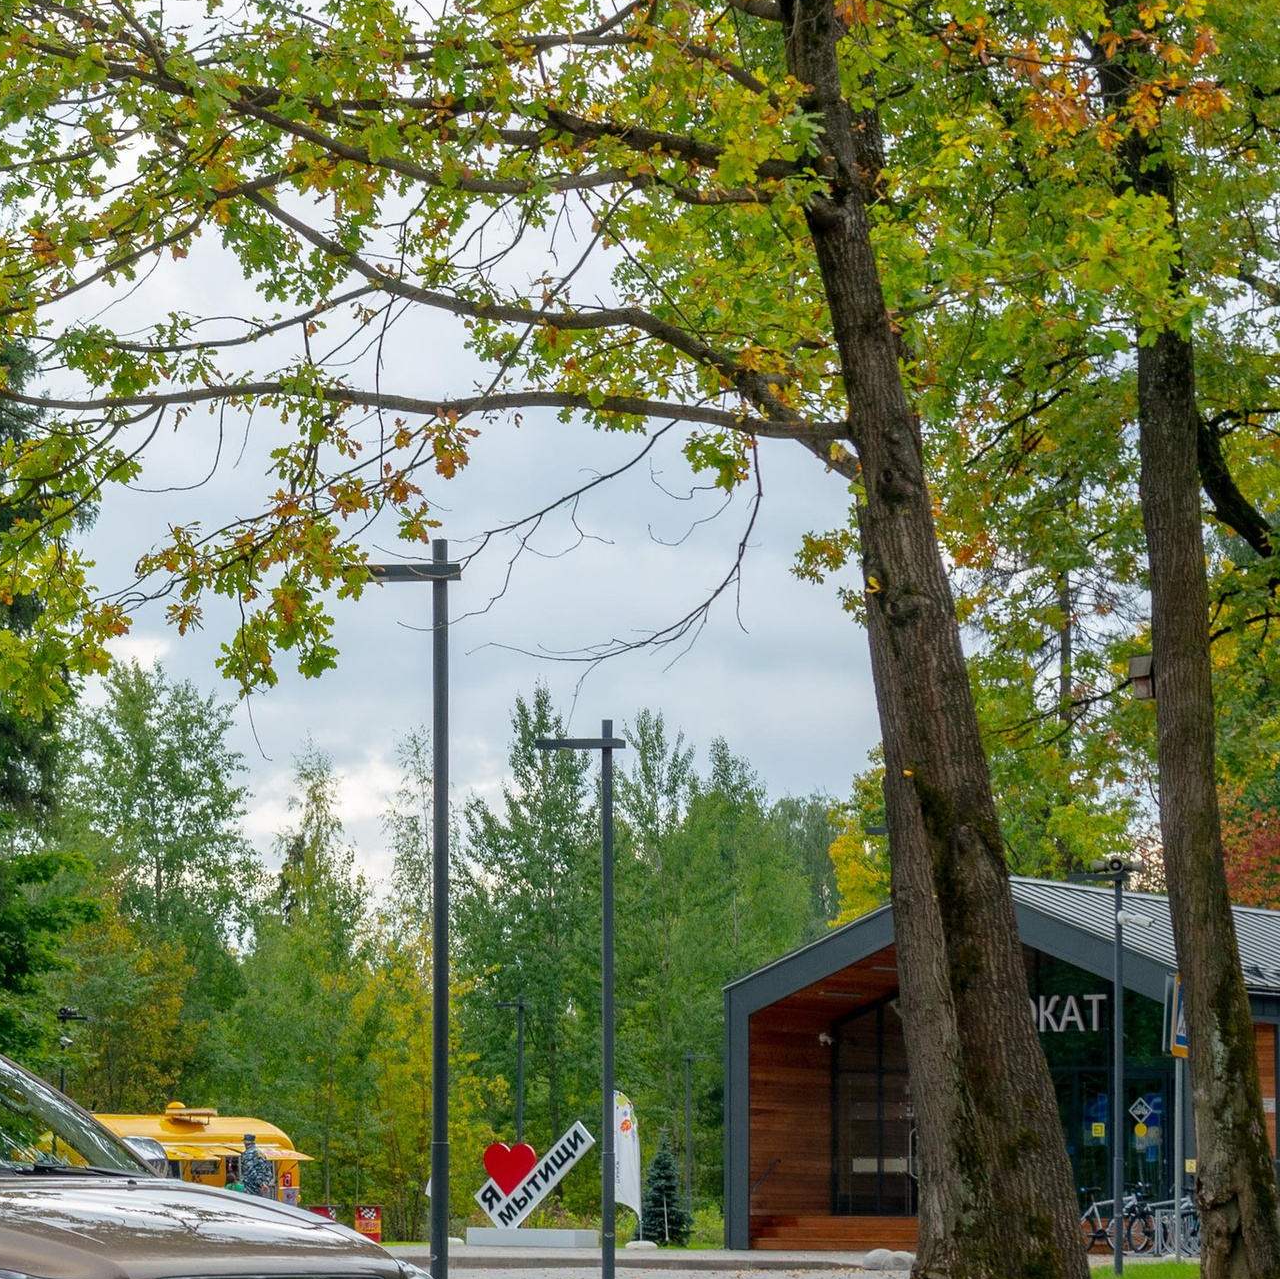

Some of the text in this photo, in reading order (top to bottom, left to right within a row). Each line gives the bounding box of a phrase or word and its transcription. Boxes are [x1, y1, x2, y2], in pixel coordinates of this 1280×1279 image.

[1029, 994, 1107, 1032] КАТ
[497, 1129, 585, 1227] МЫТИЩИ
[481, 1184, 502, 1212] Я
